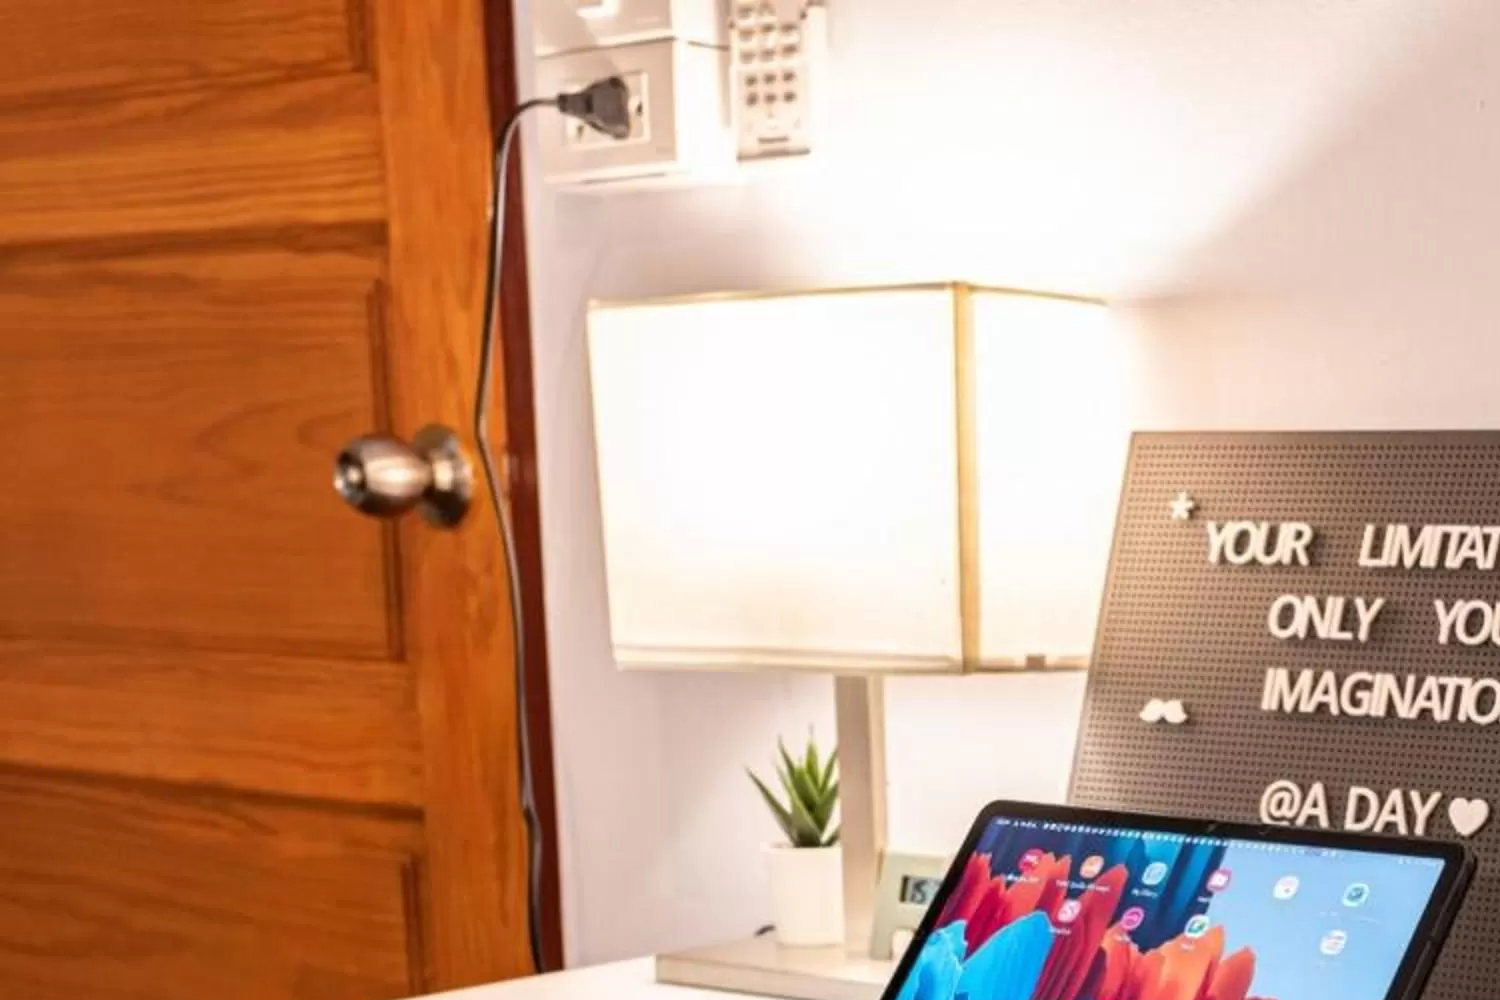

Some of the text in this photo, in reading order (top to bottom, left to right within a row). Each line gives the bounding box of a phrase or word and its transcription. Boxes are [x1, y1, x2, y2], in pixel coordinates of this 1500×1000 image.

[1205, 520, 1314, 566] YOUR
[1267, 594, 1384, 642] ONLY
[1343, 786, 1442, 837] DAY
